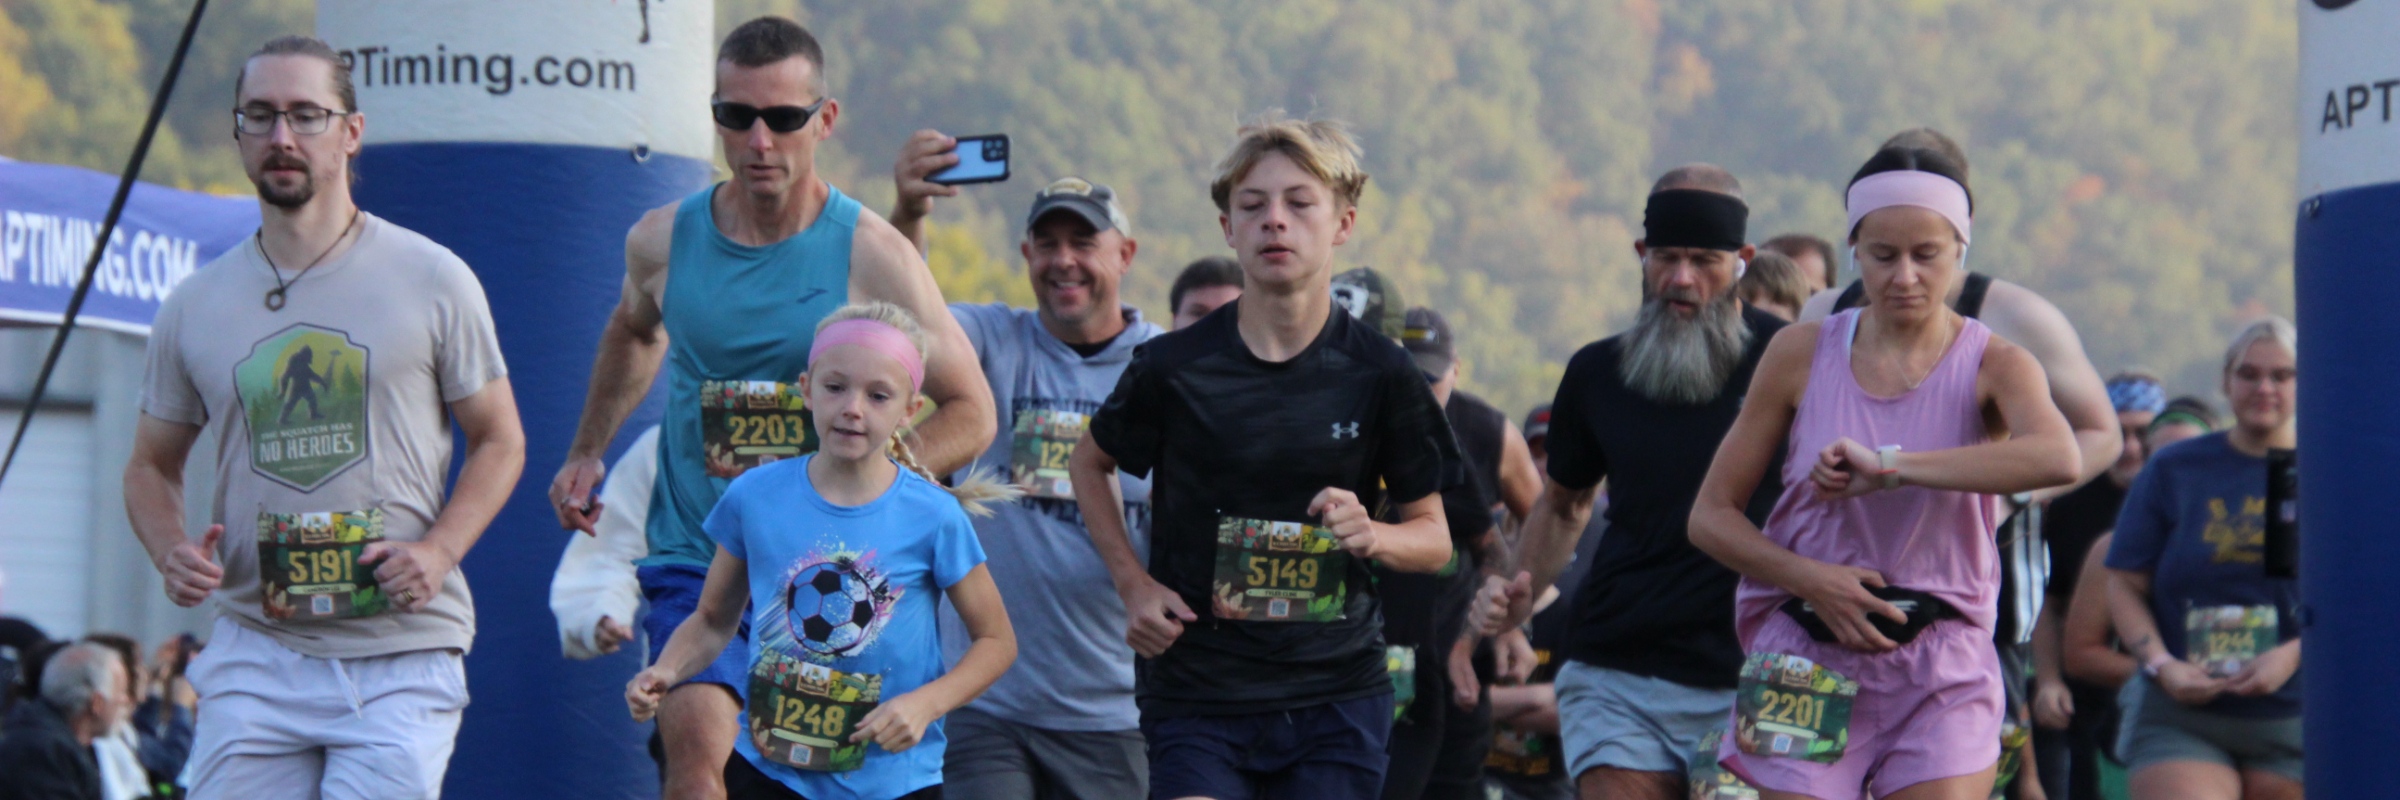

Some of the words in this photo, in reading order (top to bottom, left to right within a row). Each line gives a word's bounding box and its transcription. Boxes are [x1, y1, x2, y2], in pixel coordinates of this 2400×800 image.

[339, 45, 635, 94] PTiming.com
[2321, 80, 2400, 134] APT
[280, 425, 328, 437] SQUATCH
[330, 423, 353, 431] HAS
[729, 414, 805, 445] 2203
[260, 441, 281, 463] NO
[286, 432, 355, 459] HEROES
[1040, 441, 1075, 468] 12
[288, 549, 352, 583] 5191
[1246, 556, 1319, 588] 5149
[774, 695, 846, 737] 1248
[1757, 690, 1825, 730] 2201
